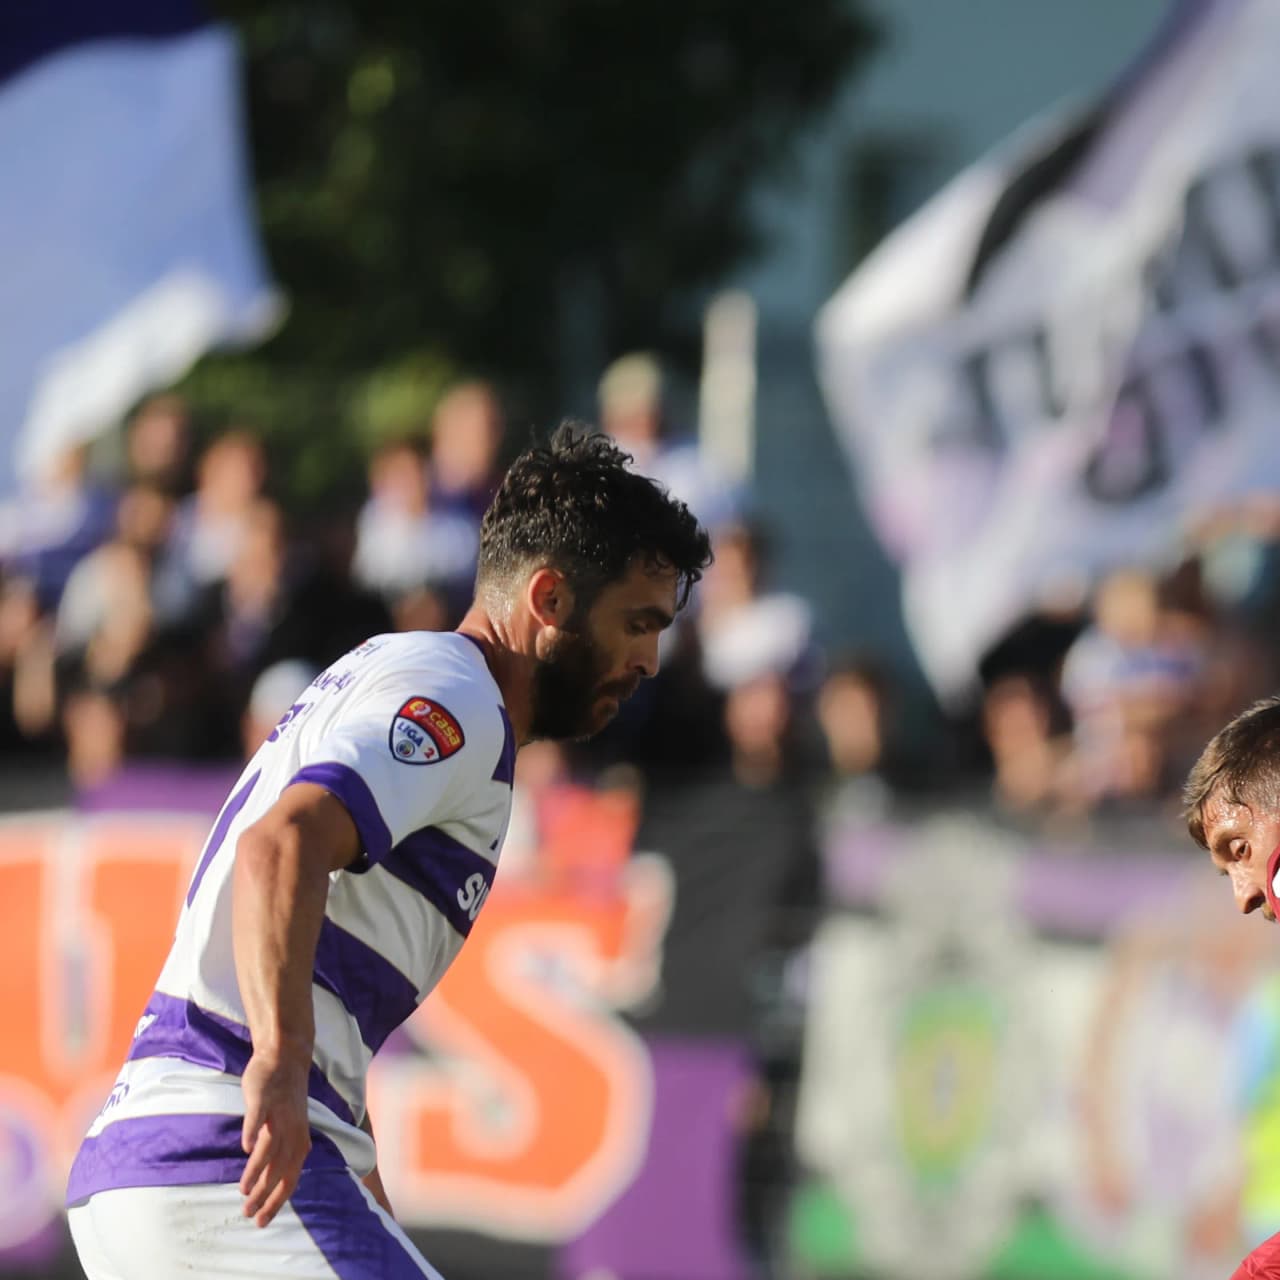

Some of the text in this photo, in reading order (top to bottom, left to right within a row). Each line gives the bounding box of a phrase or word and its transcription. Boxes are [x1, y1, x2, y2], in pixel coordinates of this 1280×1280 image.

[396, 721, 425, 747] LIGA
[423, 747, 436, 759] 2
[430, 712, 461, 746] casa
